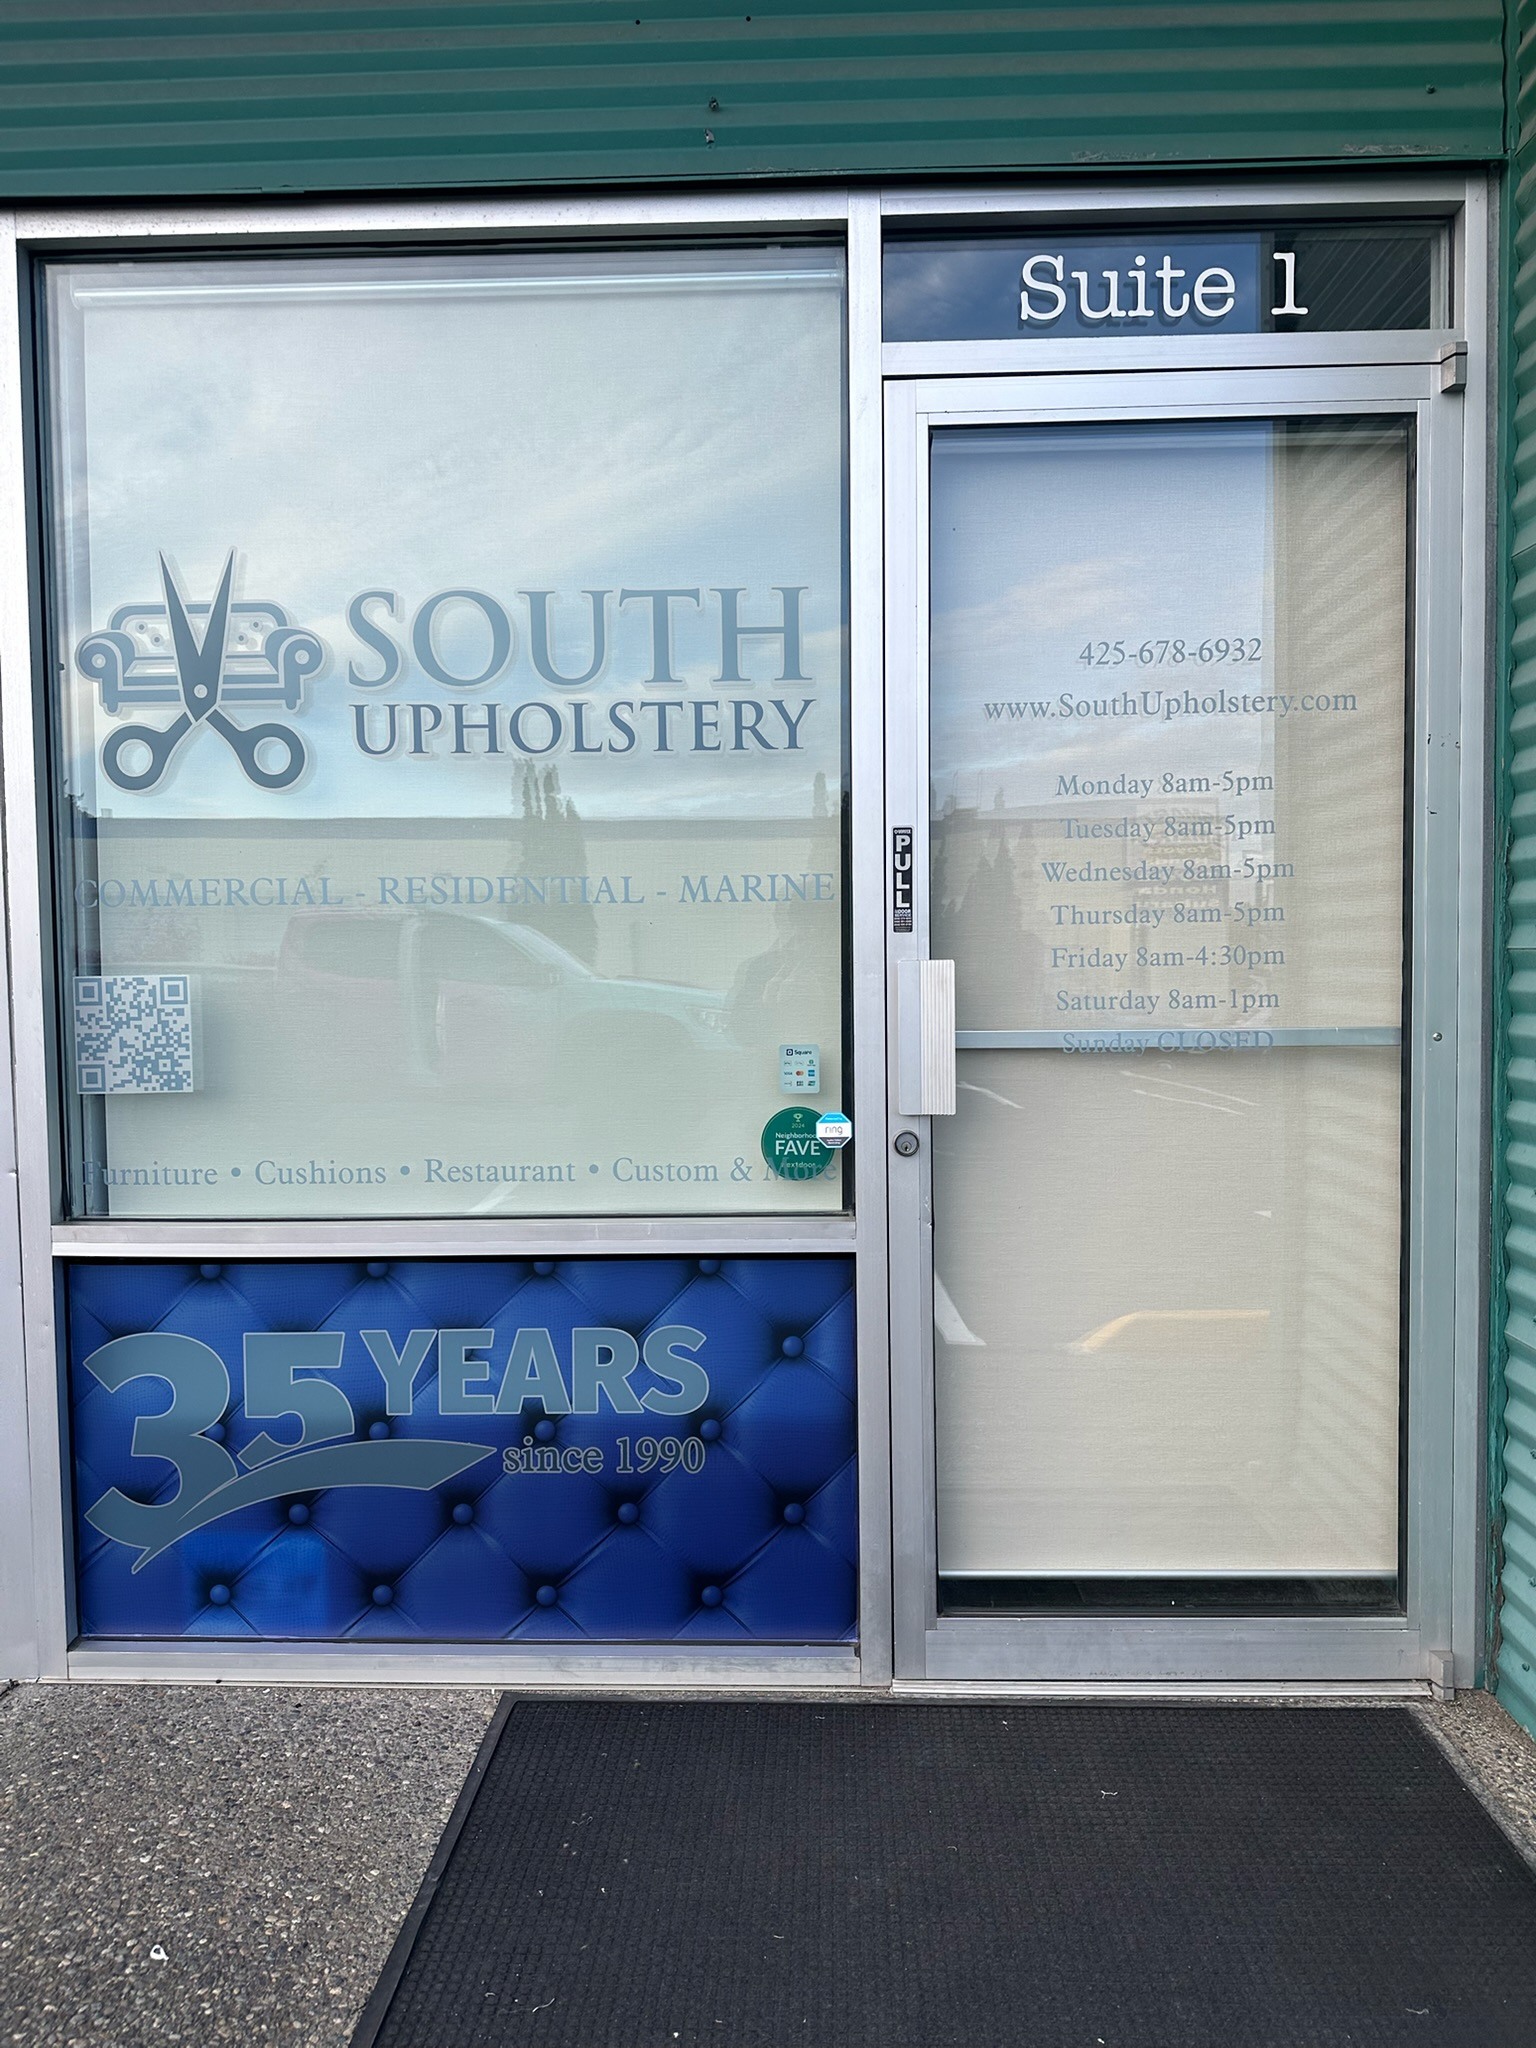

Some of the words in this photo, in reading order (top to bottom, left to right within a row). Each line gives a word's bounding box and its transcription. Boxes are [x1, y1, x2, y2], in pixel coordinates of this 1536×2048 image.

[1020, 254, 1236, 321] Suite
[1271, 251, 1309, 316] 1
[347, 585, 814, 689] SOUTH
[1078, 637, 1263, 666] 425-678-6932
[983, 689, 1358, 721] www.SouthUpholstery.com
[348, 698, 817, 756] UPHOLSTERY
[1055, 773, 1154, 798] Monday
[1161, 770, 1274, 794] 8am-5pm
[1060, 816, 1156, 842] Tuesday
[1164, 814, 1276, 839] 8am-5pm
[894, 834, 912, 908] PULL
[1041, 859, 1175, 885] Wednesday
[1182, 857, 1295, 883] 8am-5pm
[75, 876, 344, 908] COMMERCIAL
[377, 875, 646, 906] RESIDENTIAL
[678, 873, 835, 903] MARINE
[1050, 904, 1165, 928] Thursday
[1173, 902, 1286, 926] 8am-5pm
[1050, 946, 1128, 972] Friday
[1136, 944, 1286, 970] 8am-4:30pm
[1056, 990, 1160, 1015] Saturday
[1168, 988, 1280, 1013] 8am-1pm
[794, 1049, 812, 1057] Square
[1062, 1032, 1150, 1057] Sunday
[1157, 1030, 1274, 1053] CLOSED
[825, 1126, 843, 1136] ring
[775, 1140, 821, 1156] FAVE
[82, 1160, 218, 1186] Furniture
[254, 1159, 387, 1185] Cushions
[424, 1158, 576, 1183] Restaurant
[612, 1157, 719, 1182] Custom
[729, 1157, 754, 1182] &
[763, 1156, 838, 1181] More
[83, 1332, 355, 1555] 35
[359, 1325, 710, 1415] YEARS
[502, 1436, 604, 1474] since
[616, 1436, 706, 1474] 1990
